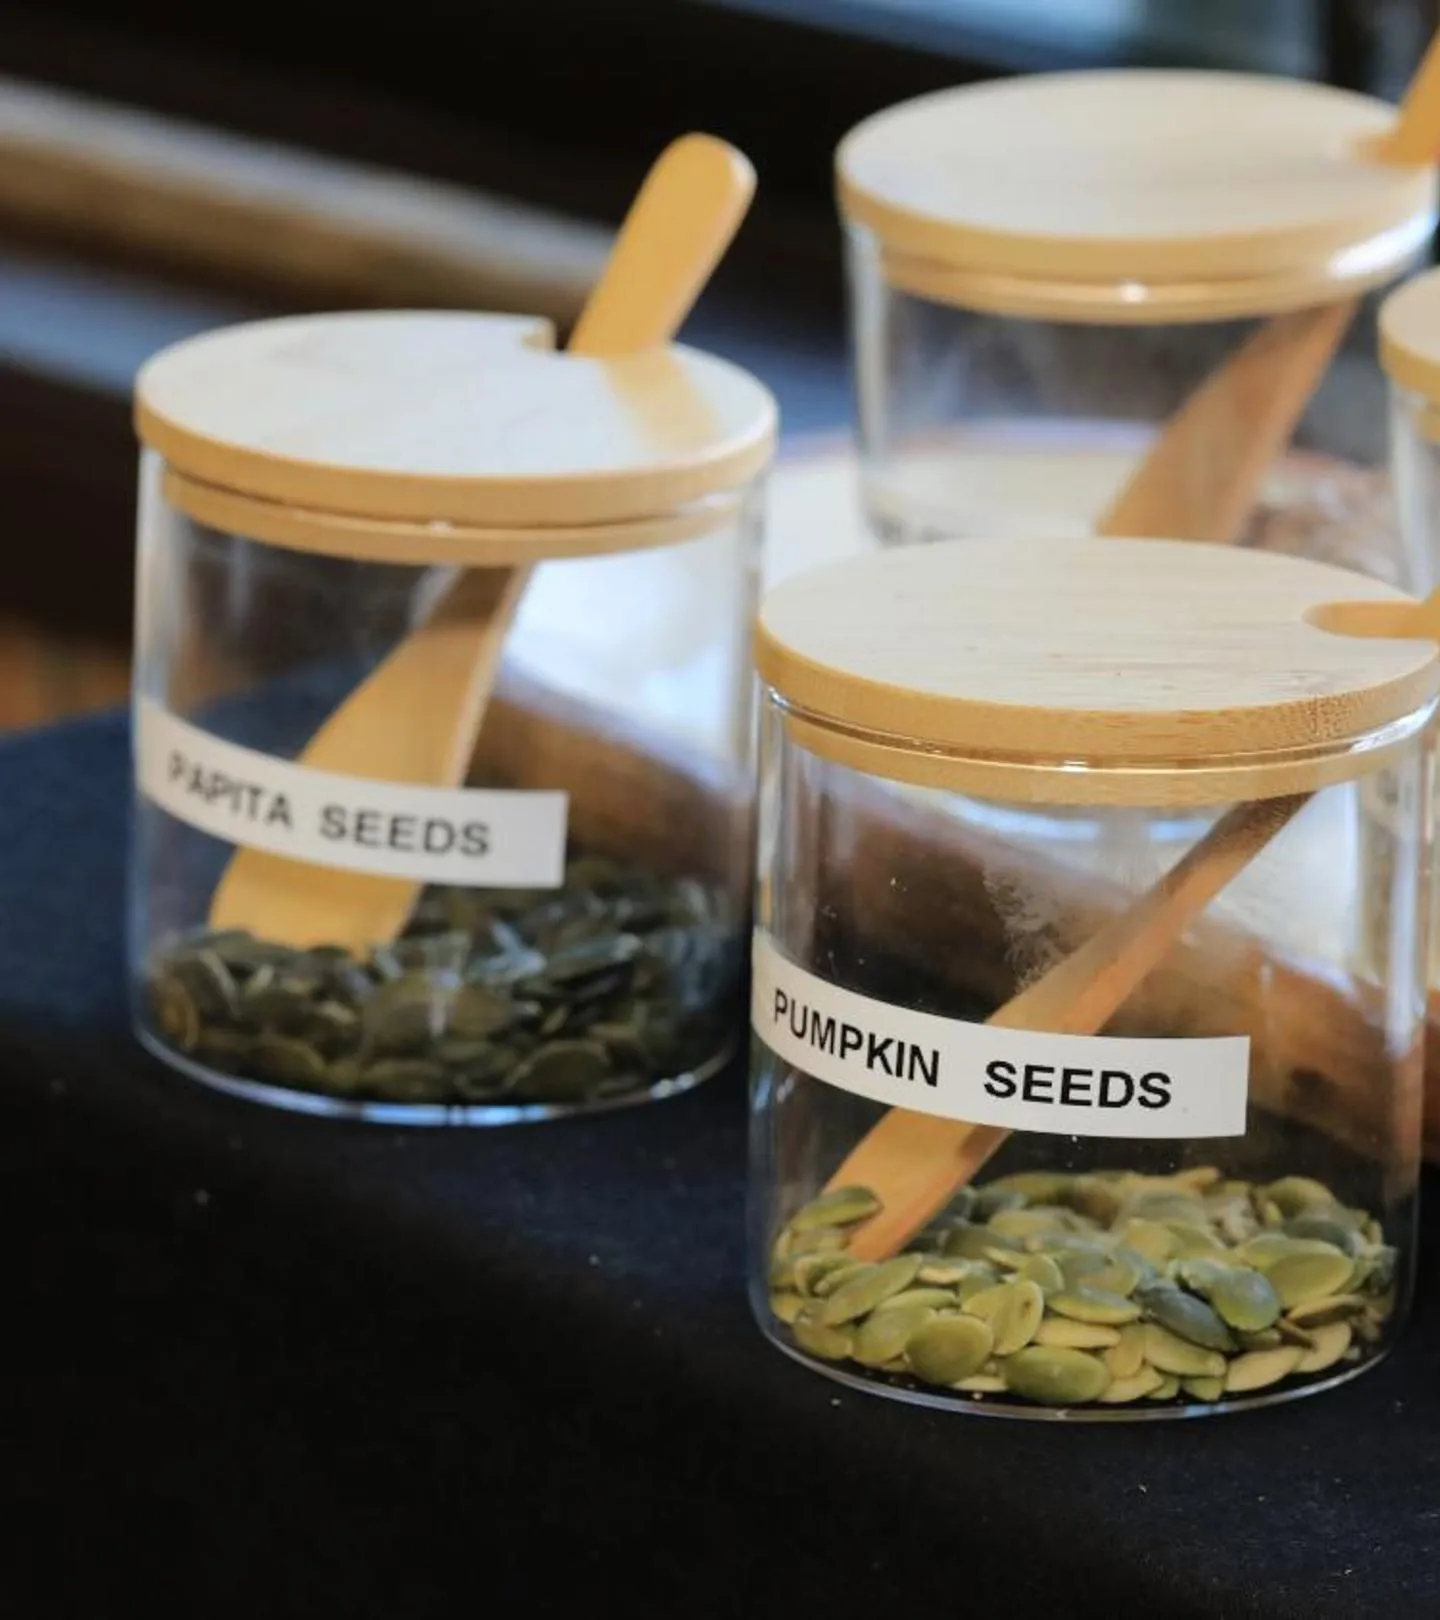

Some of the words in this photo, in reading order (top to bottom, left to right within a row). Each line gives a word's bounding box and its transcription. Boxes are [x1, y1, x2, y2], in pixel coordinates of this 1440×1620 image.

[168, 749, 293, 831] PAPITA
[318, 805, 492, 857] SEEDS
[774, 988, 940, 1087] PUMPKIN
[983, 1060, 1172, 1109] SEEDS
